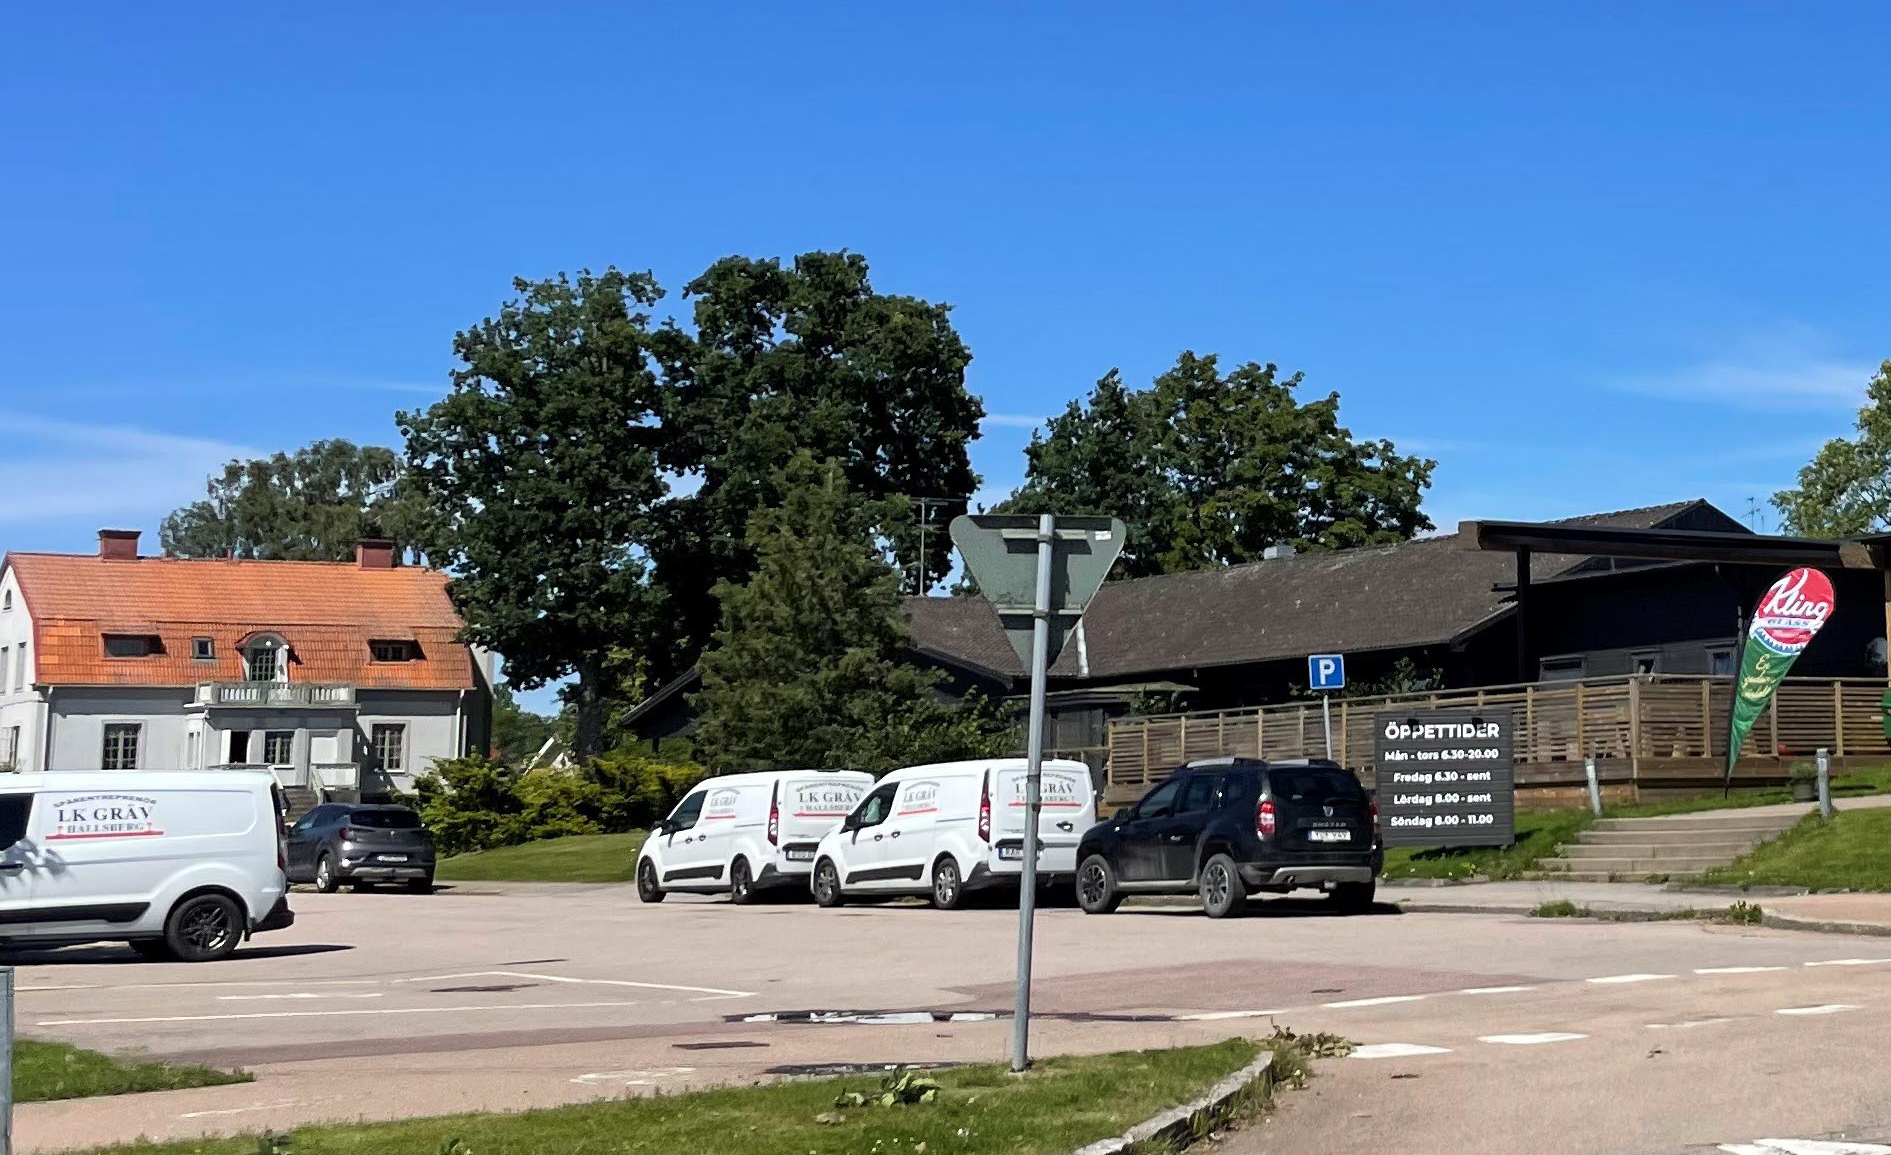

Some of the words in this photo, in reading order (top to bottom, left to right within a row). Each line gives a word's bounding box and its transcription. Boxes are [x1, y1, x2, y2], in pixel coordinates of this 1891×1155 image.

[1762, 569, 1829, 622] Kling
[1319, 658, 1335, 685] P
[1384, 721, 1500, 740] ÖPPETTIDER
[1384, 749, 1409, 761] Mån
[1417, 751, 1439, 760] tors
[1441, 748, 1499, 760] 6.30-20.00
[1393, 772, 1432, 784] Fredag
[1434, 771, 1458, 782] 6.30
[1467, 771, 1491, 781] sent
[1393, 793, 1433, 806] Lördag
[1435, 793, 1460, 803] 8.00
[1467, 793, 1492, 802] sent
[58, 808, 88, 822] LK
[93, 803, 153, 821] GRÄV
[1391, 816, 1433, 828] Söndag
[1434, 815, 1459, 826] 8.00
[1467, 814, 1494, 825] 11.00
